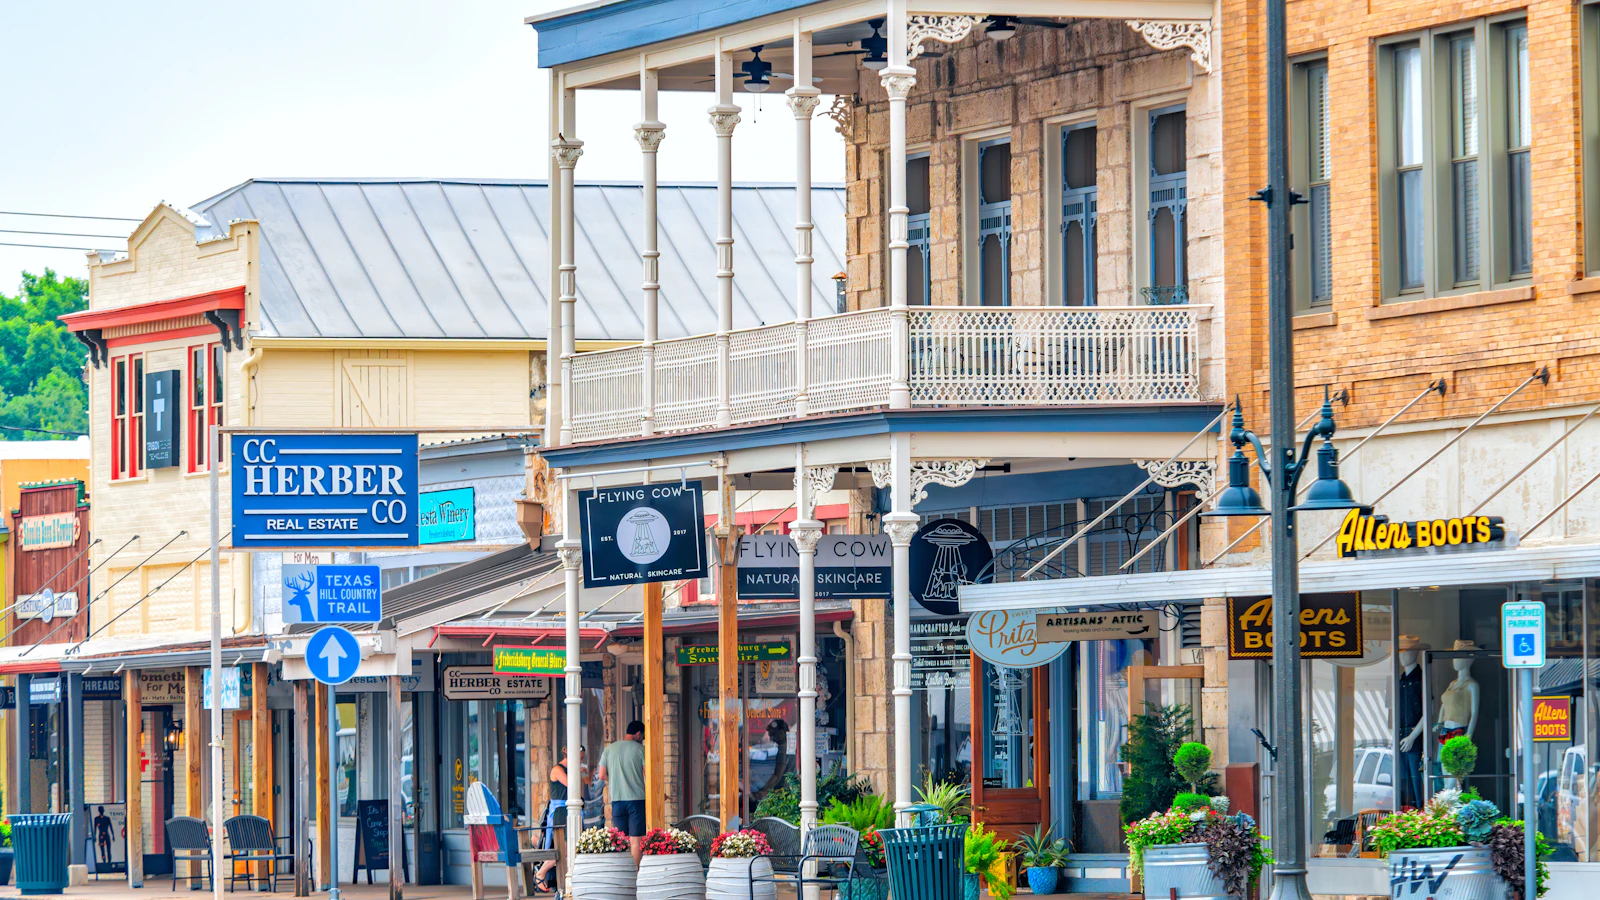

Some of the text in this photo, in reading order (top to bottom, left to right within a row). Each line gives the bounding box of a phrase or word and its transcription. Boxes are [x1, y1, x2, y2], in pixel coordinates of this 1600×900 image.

[243, 439, 276, 463] CC
[243, 465, 406, 495] HERBER
[599, 487, 682, 503] FLYING COW
[371, 500, 407, 524] CO
[267, 518, 358, 530] REAL ESTATE
[420, 501, 470, 538] esta Winery
[1336, 508, 1491, 558] Allens BOOTS
[833, 541, 886, 557] COW
[293, 552, 320, 564] For Men
[609, 568, 683, 580] NATURAL SKINCARE
[746, 573, 882, 585] NATURA SKINCARE
[325, 575, 372, 586] TEXAS
[320, 588, 378, 600] HILL COUNTRY
[327, 602, 371, 613] TRAIL
[1012, 609, 1033, 618] SWEET
[1506, 609, 1541, 617] RESERVED
[1238, 598, 1351, 630] Aens
[1046, 615, 1144, 627] ARTISANS' ATTIC
[1508, 620, 1539, 628] PARKING
[910, 623, 949, 633] HANDCRAFTED
[977, 609, 1037, 656] Pritz
[531, 652, 549, 668] General
[549, 652, 563, 669] Store
[689, 653, 759, 664] Souirs
[141, 671, 185, 681] ometh
[347, 675, 377, 684] iesta
[81, 680, 120, 691] THREADS
[146, 682, 185, 694] For Me
[449, 678, 501, 688] HERBER
[507, 679, 543, 688] ESTATE
[1533, 701, 1567, 723] Allens
[1535, 724, 1567, 736] BOOTS
